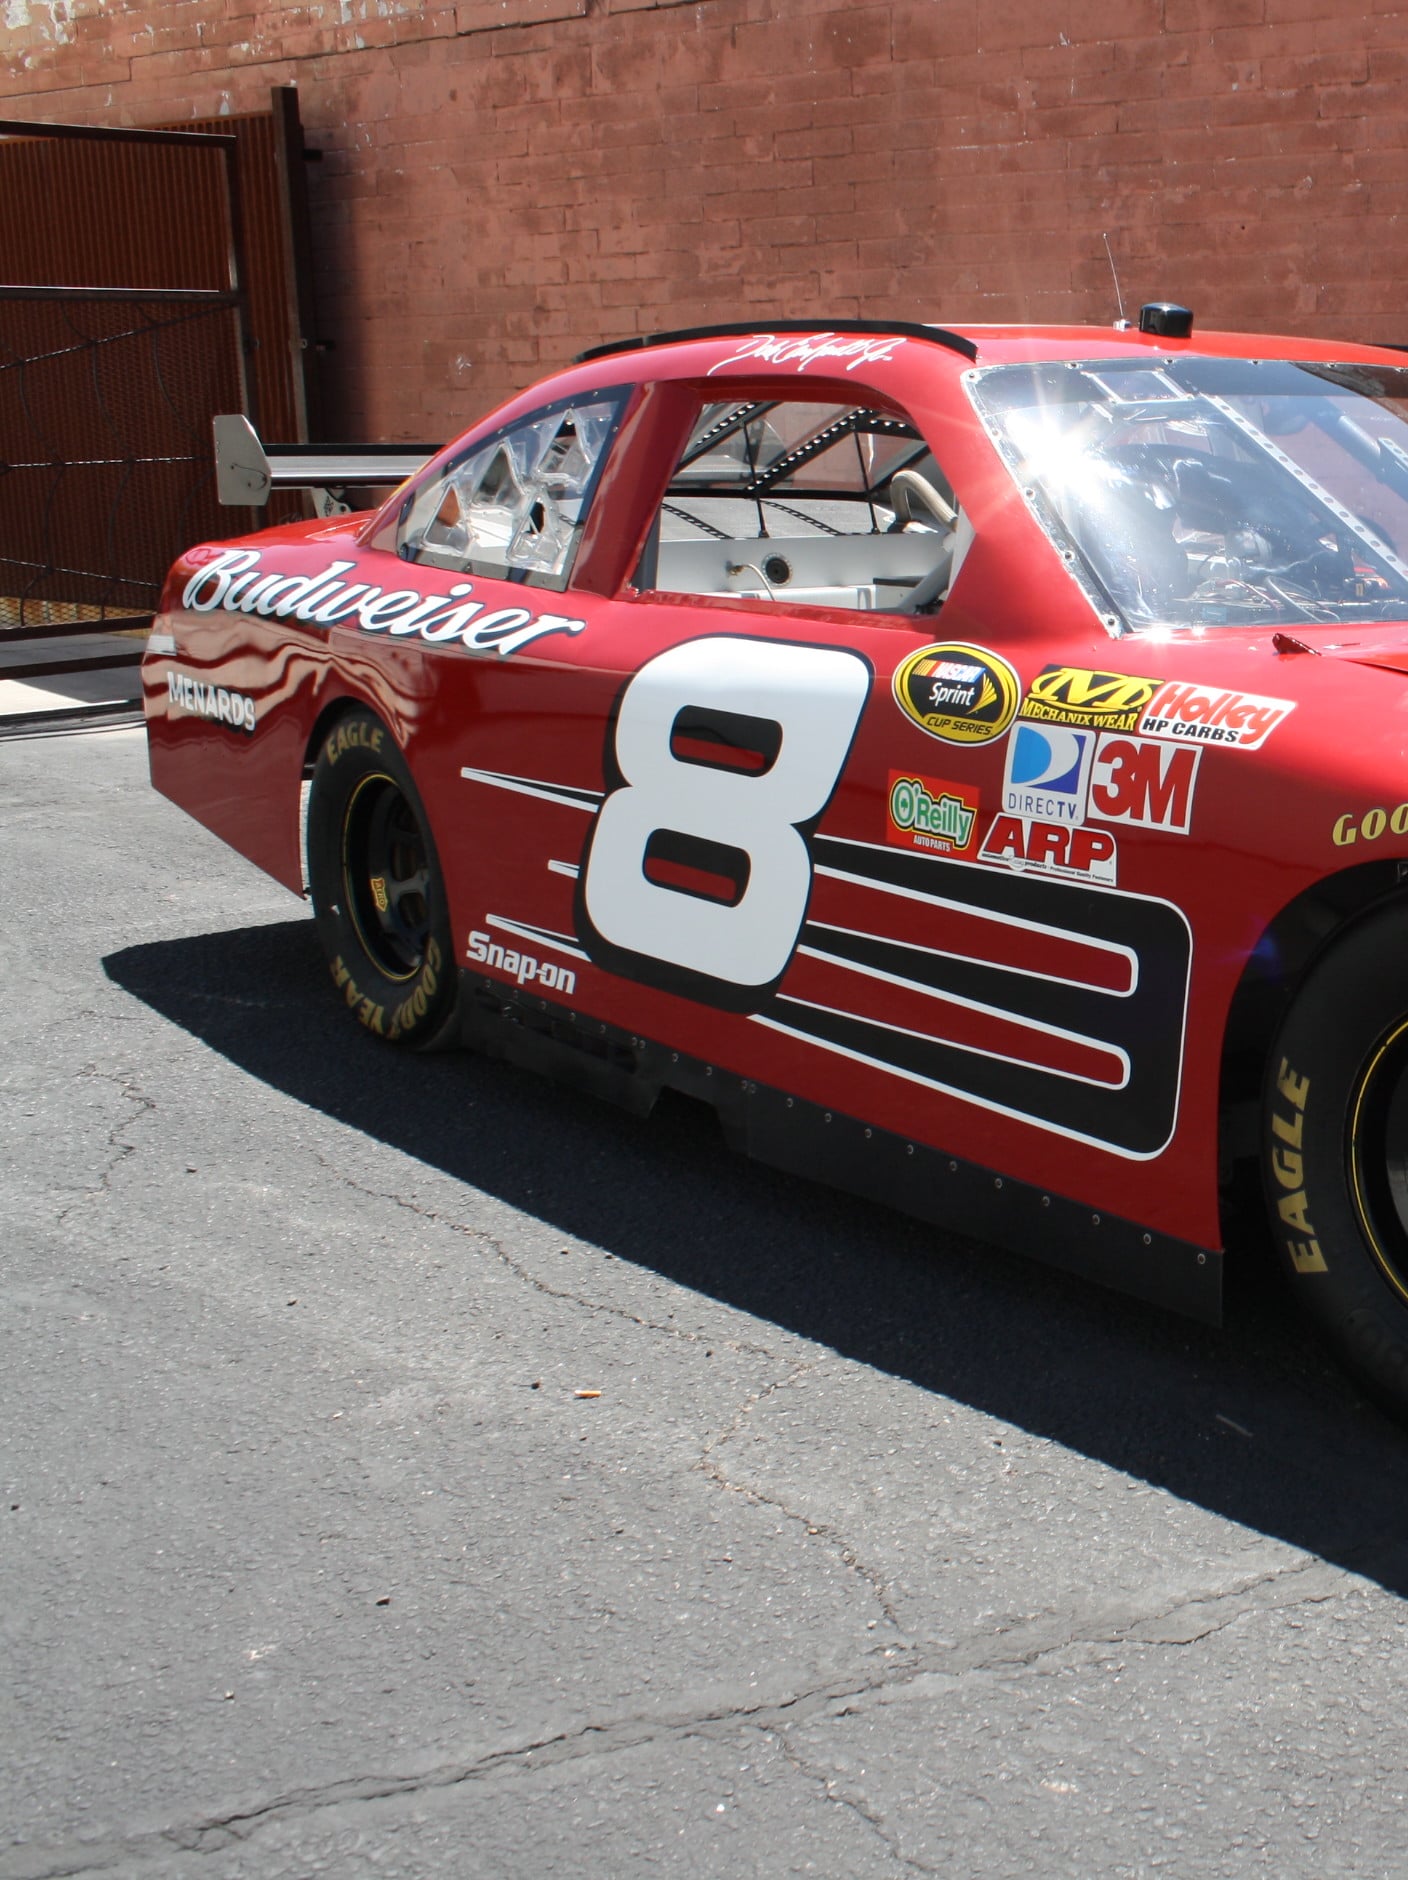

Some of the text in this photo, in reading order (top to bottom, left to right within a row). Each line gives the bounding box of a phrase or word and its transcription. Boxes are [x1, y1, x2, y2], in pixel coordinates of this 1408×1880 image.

[182, 549, 586, 656] Budweiser
[167, 672, 255, 732] MENARDS
[929, 682, 975, 707] Sprint
[1018, 698, 1138, 731] MECHANIX WEAR
[1148, 683, 1284, 744] Holley
[325, 721, 384, 765] EAGLE
[927, 717, 992, 735] CUP SERIES
[1142, 718, 1239, 743] HP CARBS
[585, 637, 870, 986] 8
[893, 782, 972, 844] O'Reilly
[1008, 793, 1077, 821] DIRECTV
[1092, 740, 1197, 830] 3M
[930, 838, 951, 852] PARTS
[983, 818, 1114, 871] ARP
[466, 930, 576, 994] Snap-on
[1272, 1057, 1328, 1273] EAGLE
